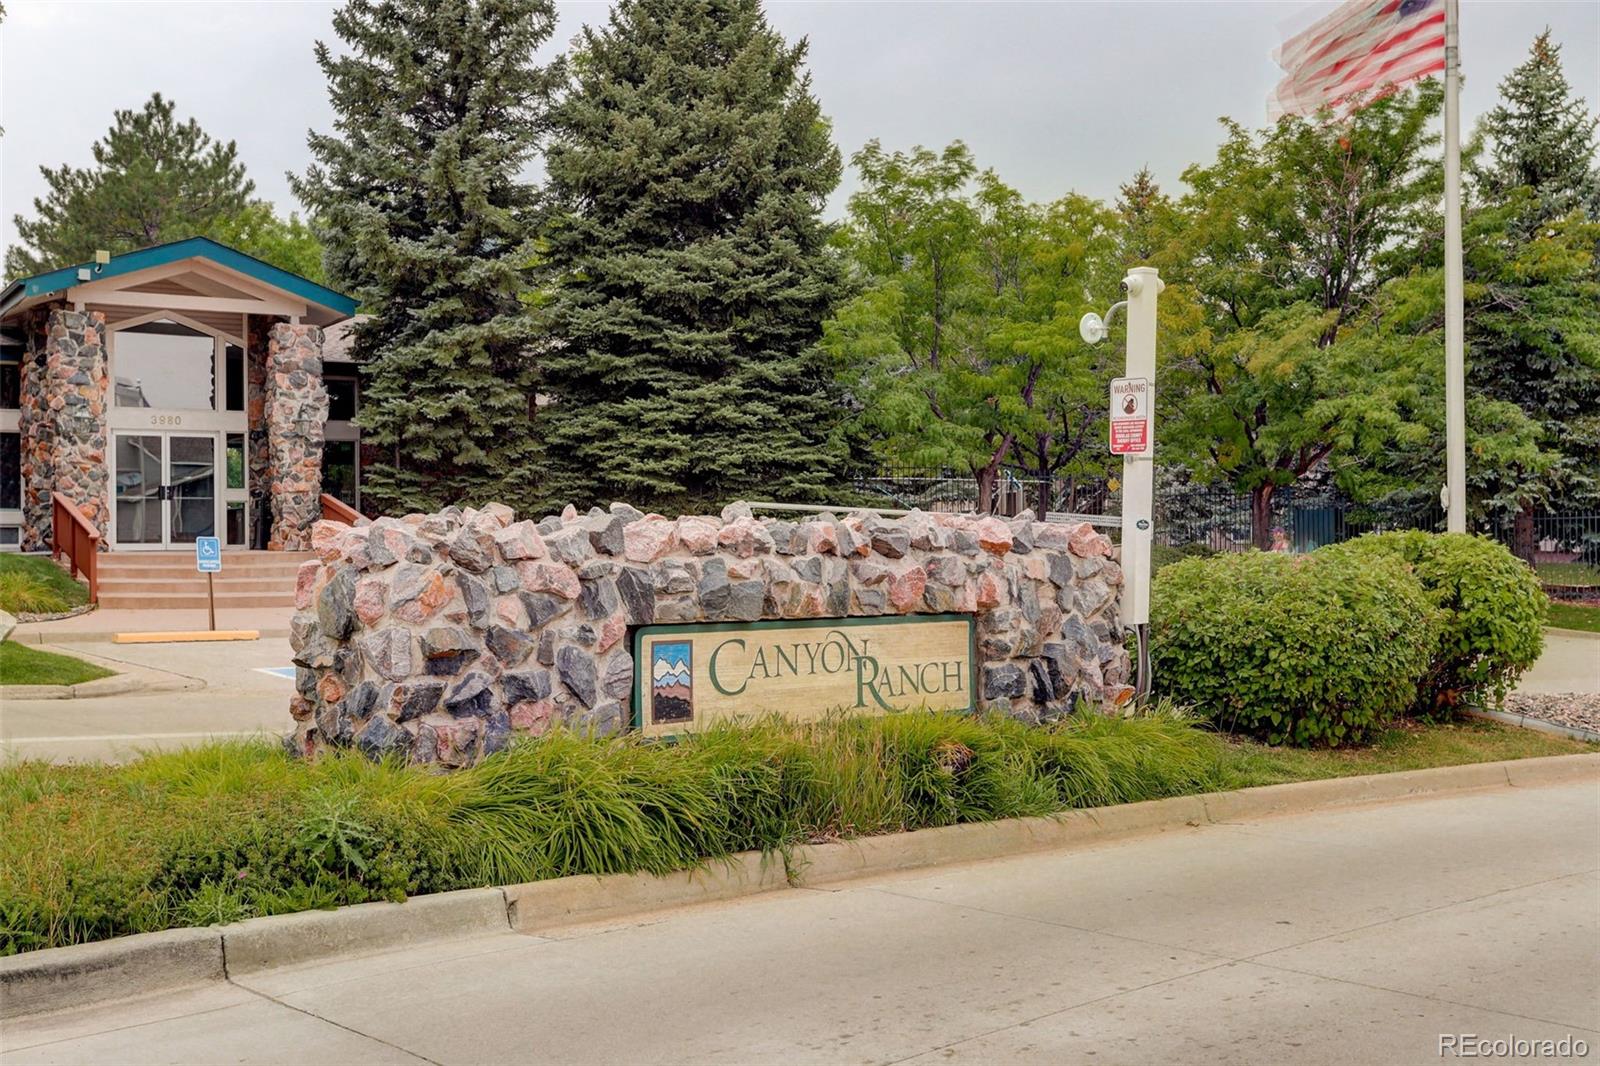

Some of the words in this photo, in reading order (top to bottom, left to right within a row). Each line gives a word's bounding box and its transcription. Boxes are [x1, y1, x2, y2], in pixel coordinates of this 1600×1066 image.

[1114, 383, 1145, 394] WARNING
[151, 415, 182, 425] 3980
[709, 630, 868, 696] CANYON
[852, 655, 963, 712] RANCH
